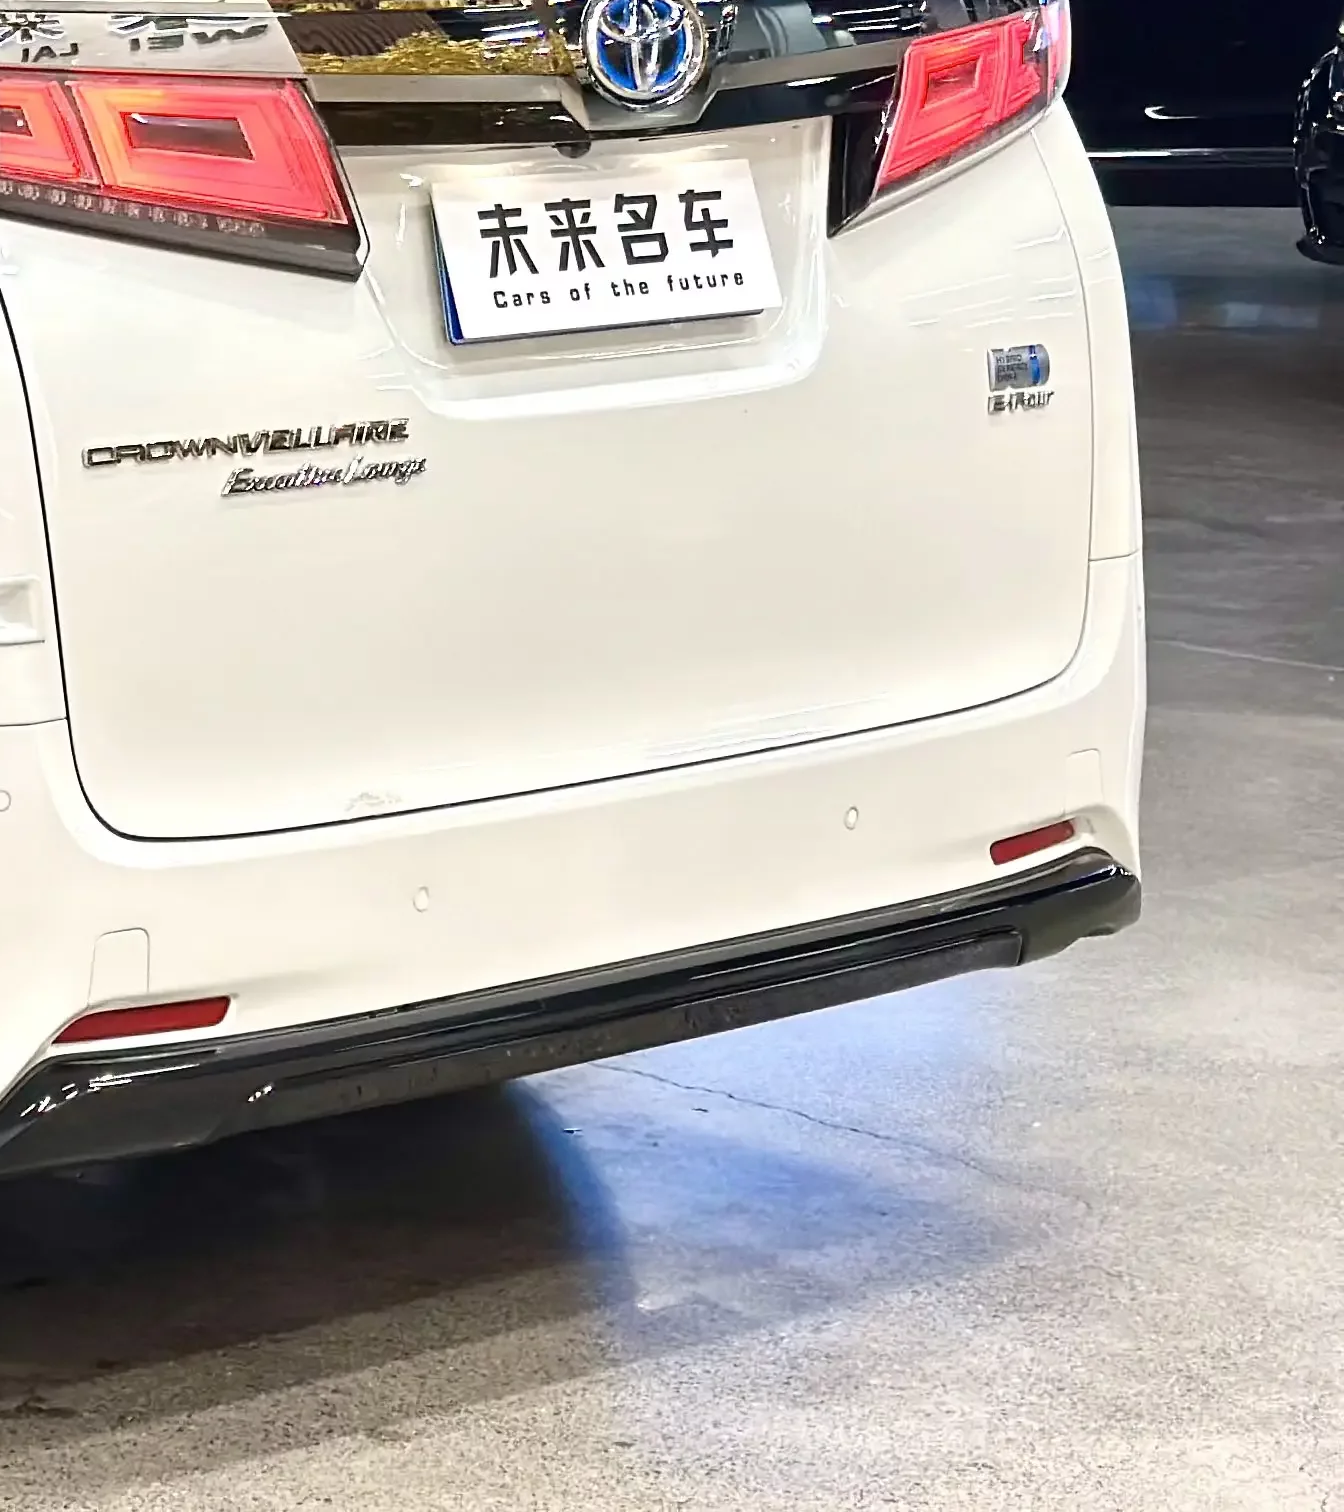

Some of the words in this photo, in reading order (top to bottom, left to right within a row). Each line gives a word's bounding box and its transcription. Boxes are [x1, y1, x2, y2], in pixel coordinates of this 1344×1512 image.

[477, 189, 734, 278] 未来名车
[493, 290, 551, 308] Cars
[570, 282, 592, 302] of
[611, 278, 650, 298] the
[667, 271, 744, 292] future
